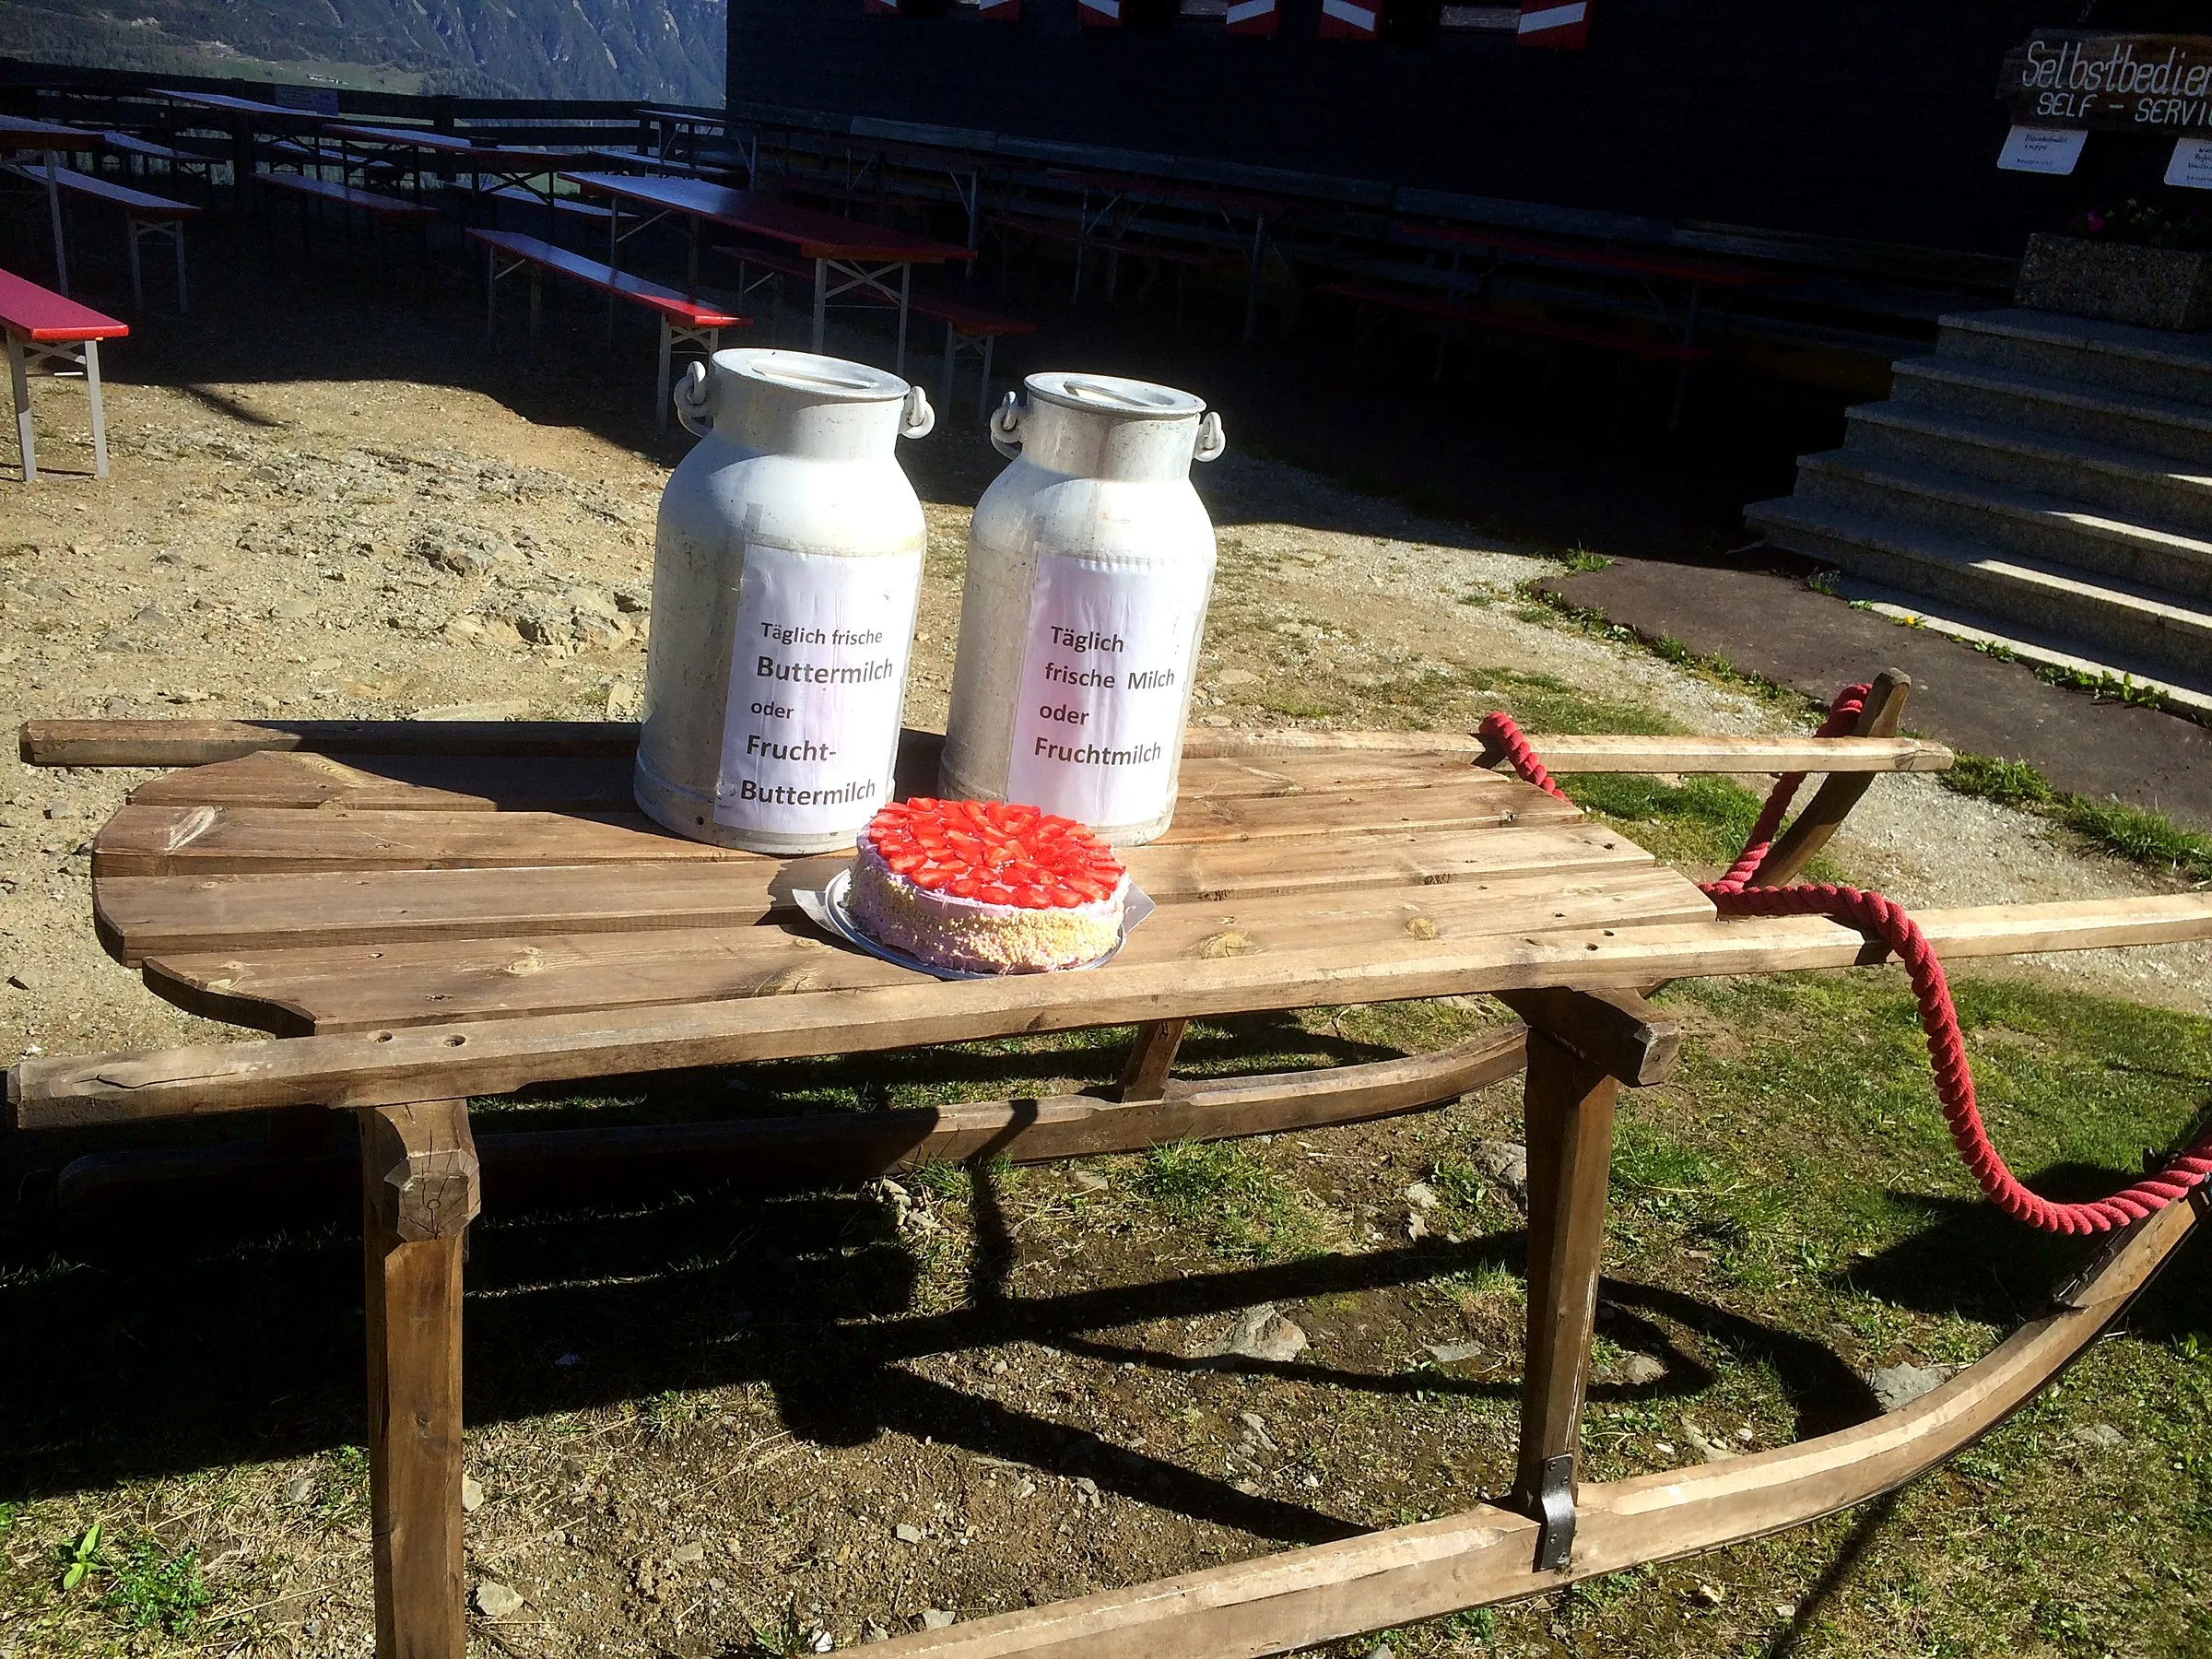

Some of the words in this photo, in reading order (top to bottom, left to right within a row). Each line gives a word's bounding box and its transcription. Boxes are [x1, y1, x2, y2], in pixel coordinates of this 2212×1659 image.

[2037, 91, 2098, 118] SELF
[2135, 98, 2212, 125] SERVI
[761, 622, 826, 645] Täglich
[832, 629, 883, 645] frische
[1051, 626, 1124, 653] Täglich
[757, 655, 893, 684] Buttermilch
[1044, 662, 1115, 688] frische
[1127, 668, 1174, 689] Milch
[750, 700, 794, 719] oder
[1040, 704, 1089, 725] oder
[746, 734, 836, 761] Frucht-
[1034, 736, 1161, 766] Fruchtmilch
[740, 779, 876, 806] Buttermilch
